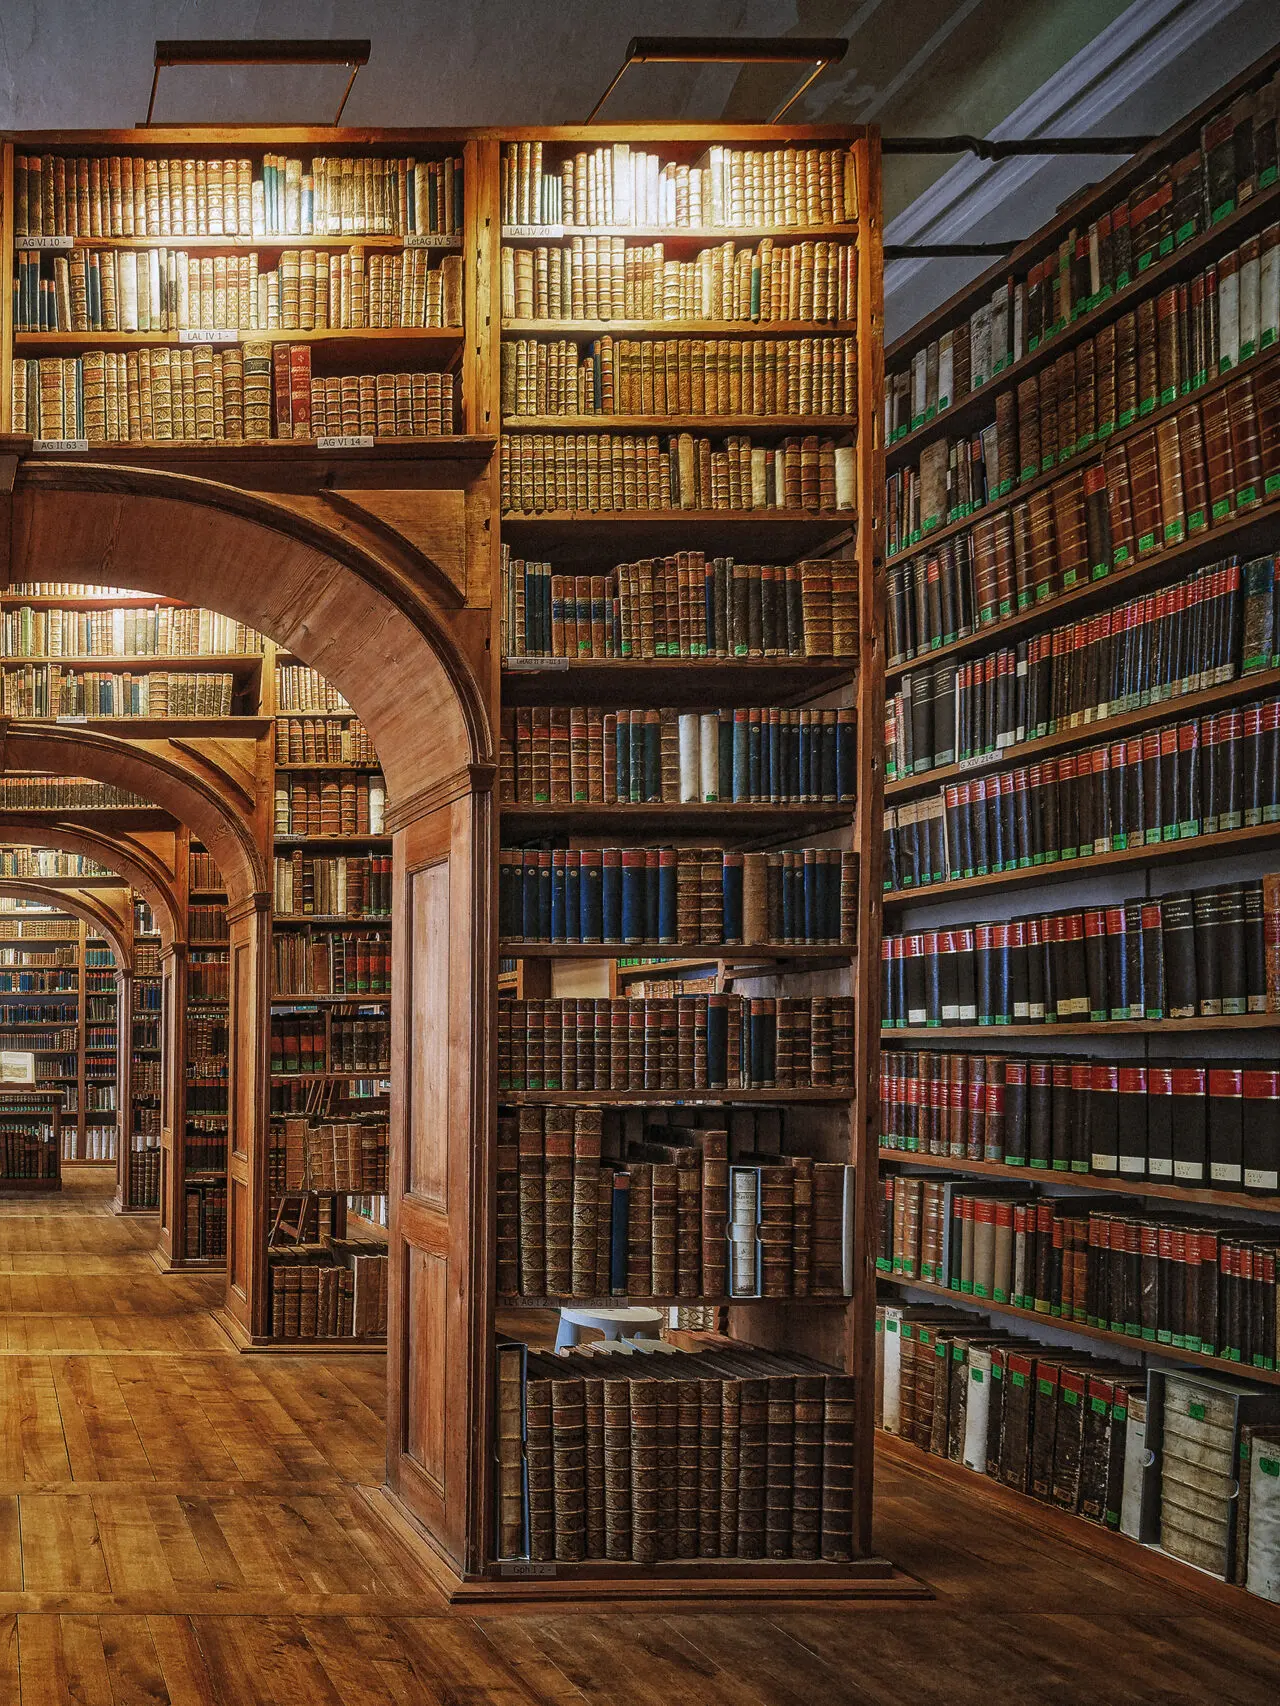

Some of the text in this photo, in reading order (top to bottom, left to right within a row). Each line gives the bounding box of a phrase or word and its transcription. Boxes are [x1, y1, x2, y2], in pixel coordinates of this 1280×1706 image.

[510, 228, 551, 236] LAL IV 20
[22, 238, 36, 248] AG
[37, 238, 47, 248] VI
[49, 238, 60, 248] 10
[407, 237, 432, 246] LetAG
[434, 237, 444, 246] IV
[445, 237, 452, 246] 5
[187, 332, 203, 341] LAL
[205, 332, 215, 341] IV
[218, 332, 222, 341] 1
[40, 442, 55, 450] AG
[56, 442, 64, 450] II
[66, 442, 78, 450] 63
[322, 438, 336, 447] AG
[338, 438, 348, 447] VI
[350, 438, 361, 447] 14
[960, 762, 967, 770] G
[967, 757, 980, 768] XIV
[980, 753, 995, 764] 214
[513, 1566, 531, 1575] Gph
[533, 1566, 537, 1574] I
[540, 1566, 546, 1574] 2
